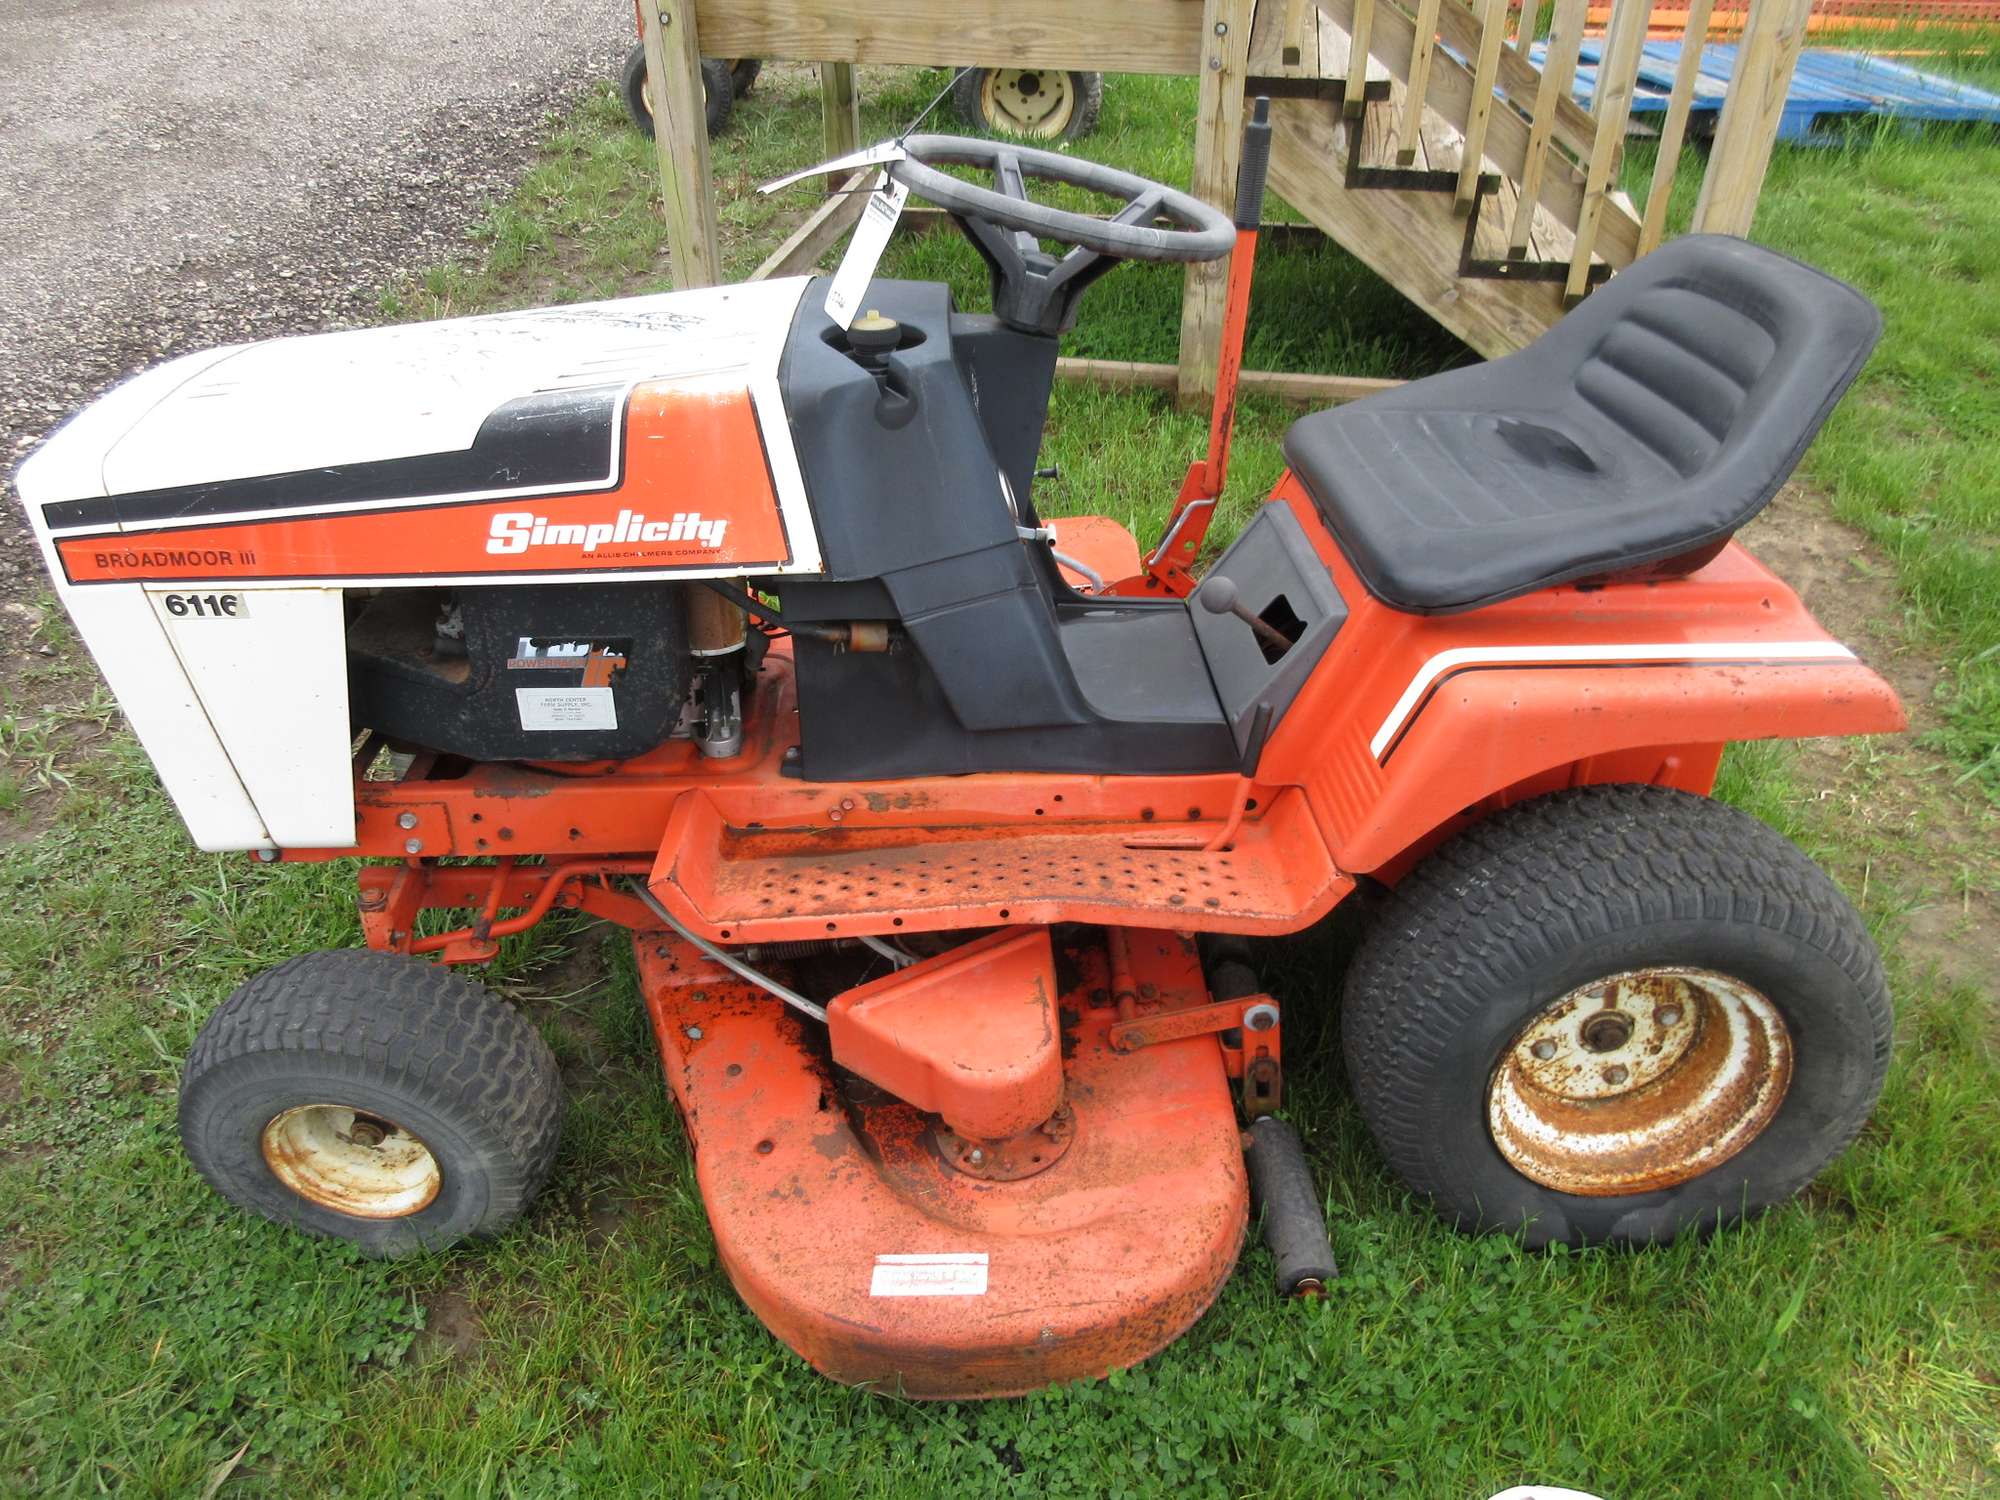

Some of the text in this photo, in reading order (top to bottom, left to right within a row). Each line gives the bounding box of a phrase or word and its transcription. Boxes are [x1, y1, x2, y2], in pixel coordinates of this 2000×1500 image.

[486, 509, 728, 554] Simplicity
[95, 551, 233, 568] BROADMOOR
[675, 548, 721, 556] COMPANY
[165, 594, 238, 616] 6116
